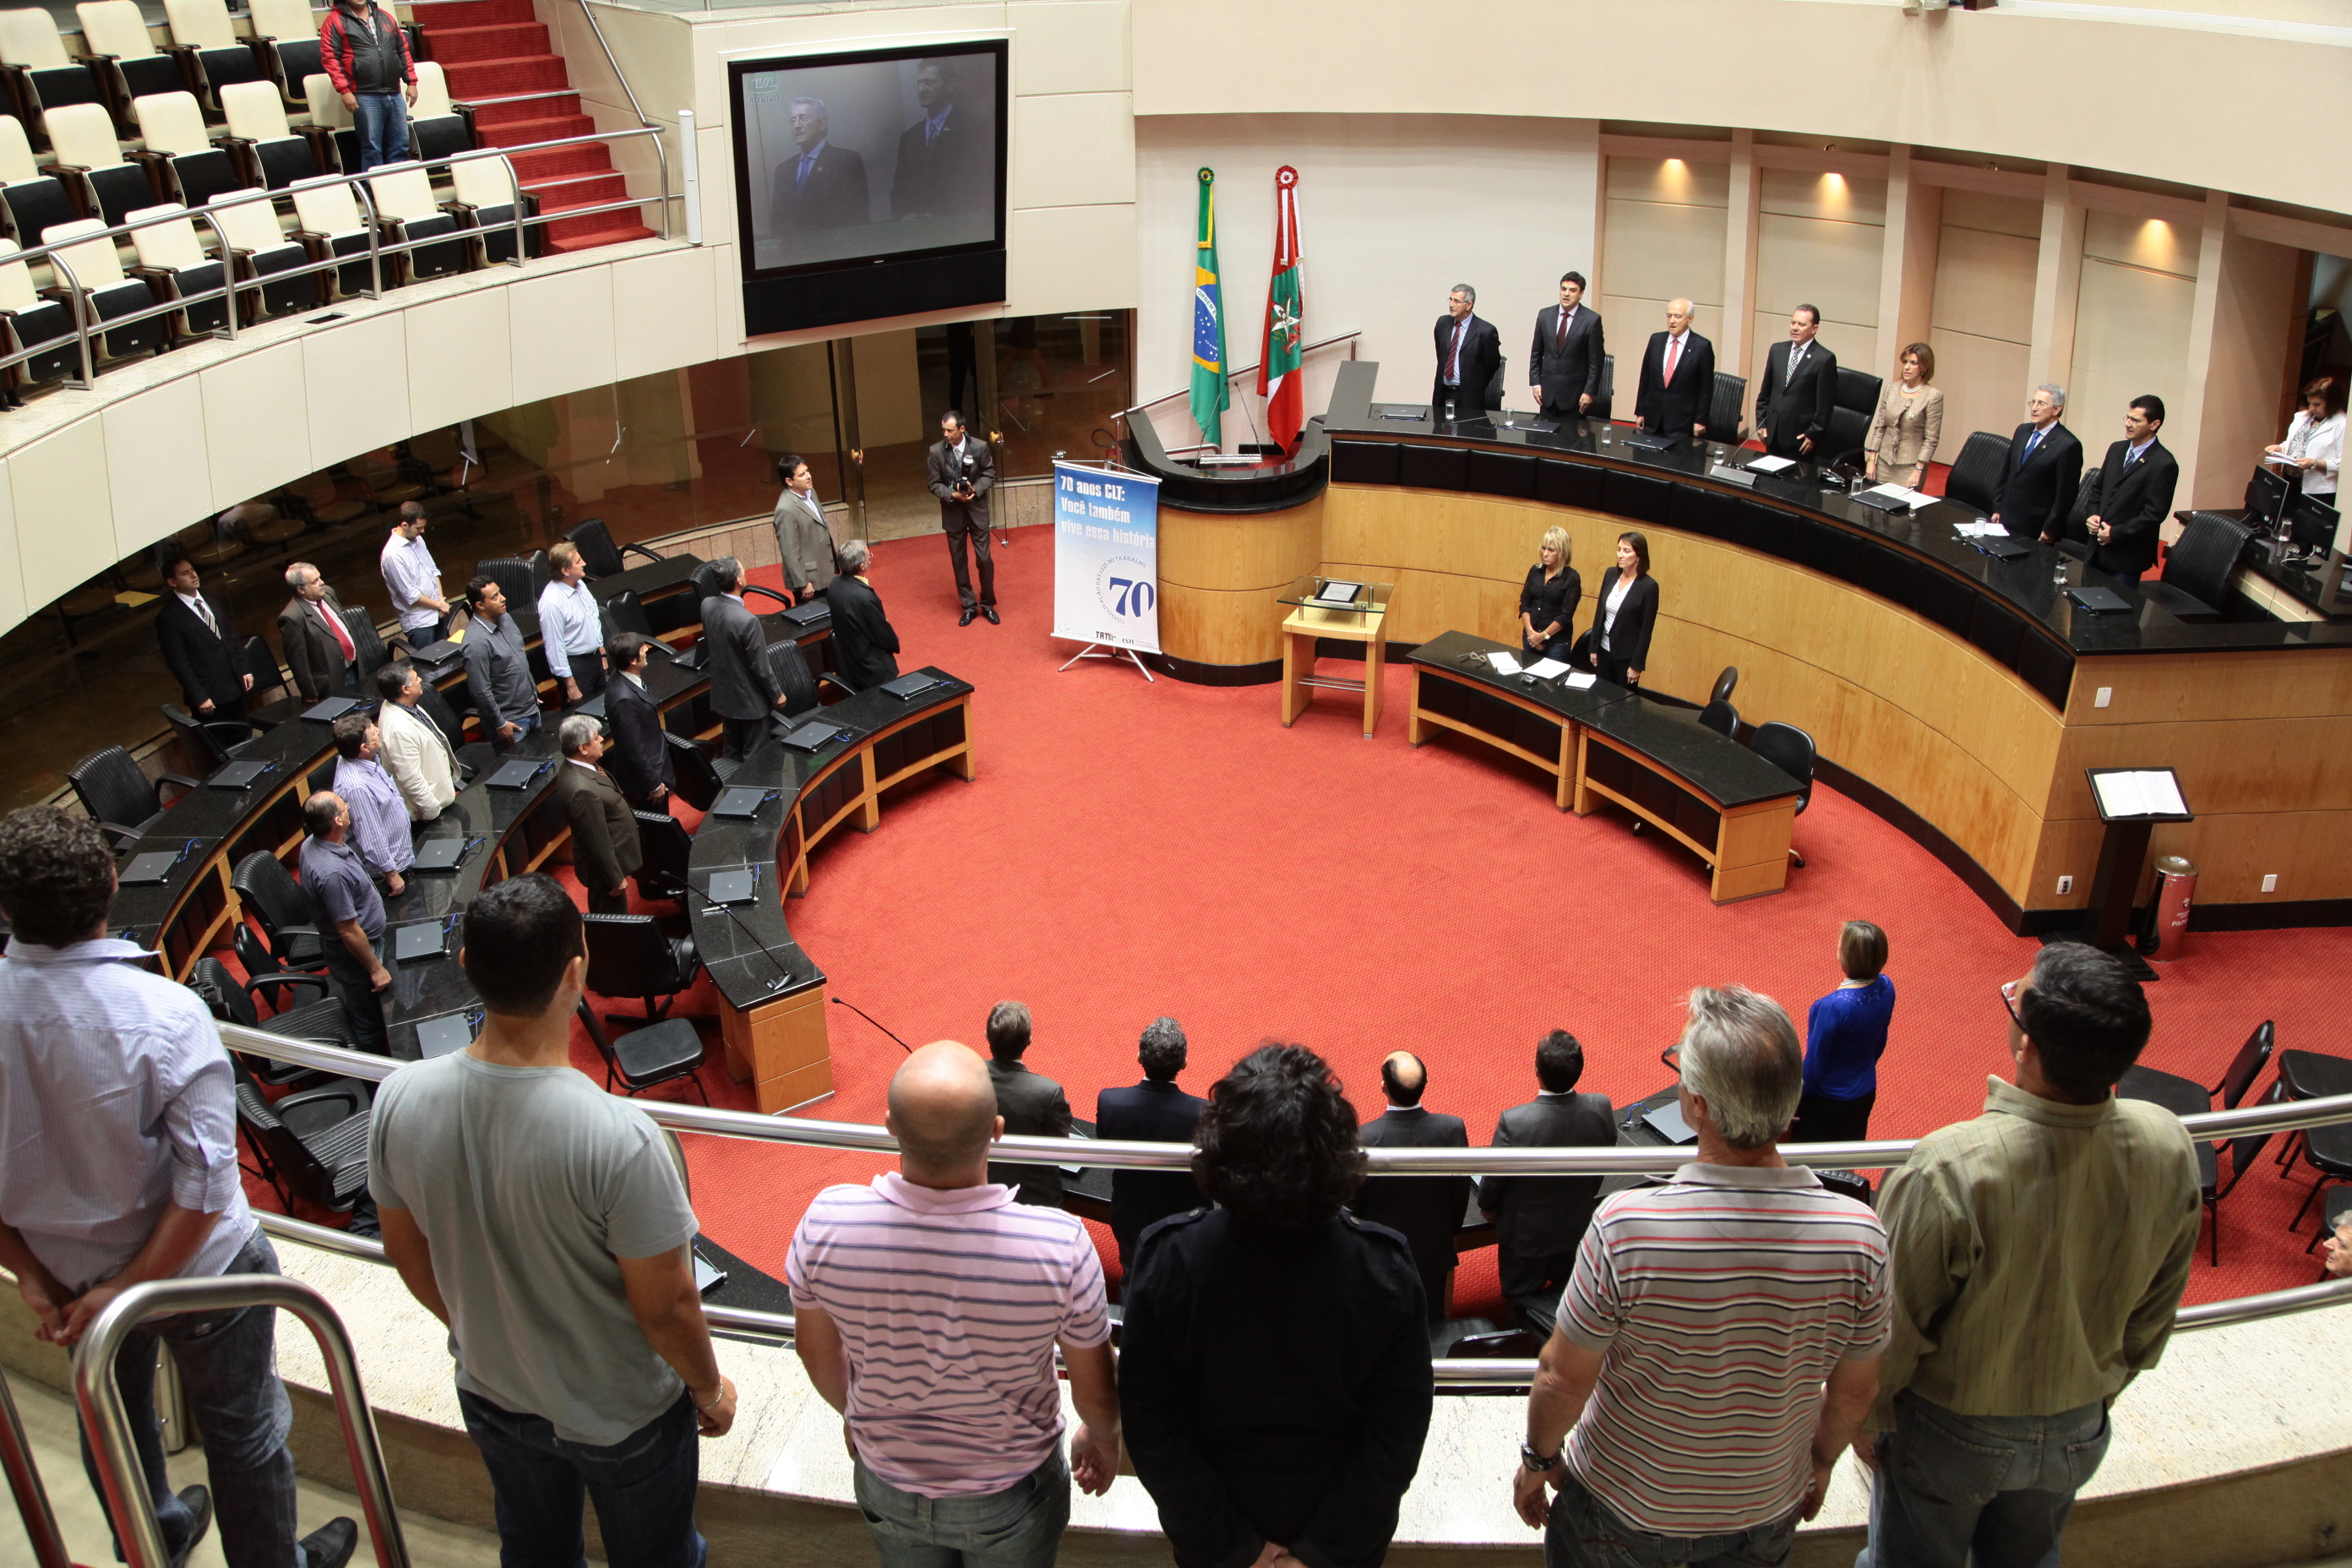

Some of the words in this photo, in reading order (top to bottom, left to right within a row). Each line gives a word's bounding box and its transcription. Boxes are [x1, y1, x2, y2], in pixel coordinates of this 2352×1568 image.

[1197, 291, 1214, 310] ORDEM
[1061, 475, 1074, 492] 70
[1076, 481, 1102, 497] anos
[1104, 483, 1125, 502] CLT:
[1060, 497, 1086, 515] Você
[1088, 502, 1130, 523] também
[1061, 519, 1082, 536] vive
[1086, 525, 1109, 541] essa
[1113, 528, 1155, 549] história
[1099, 562, 1108, 574] LEIS
[1115, 555, 1146, 568] TRABALHO
[1096, 586, 1125, 624] CONSOLIDAÇÃO
[1109, 576, 1154, 618] 70
